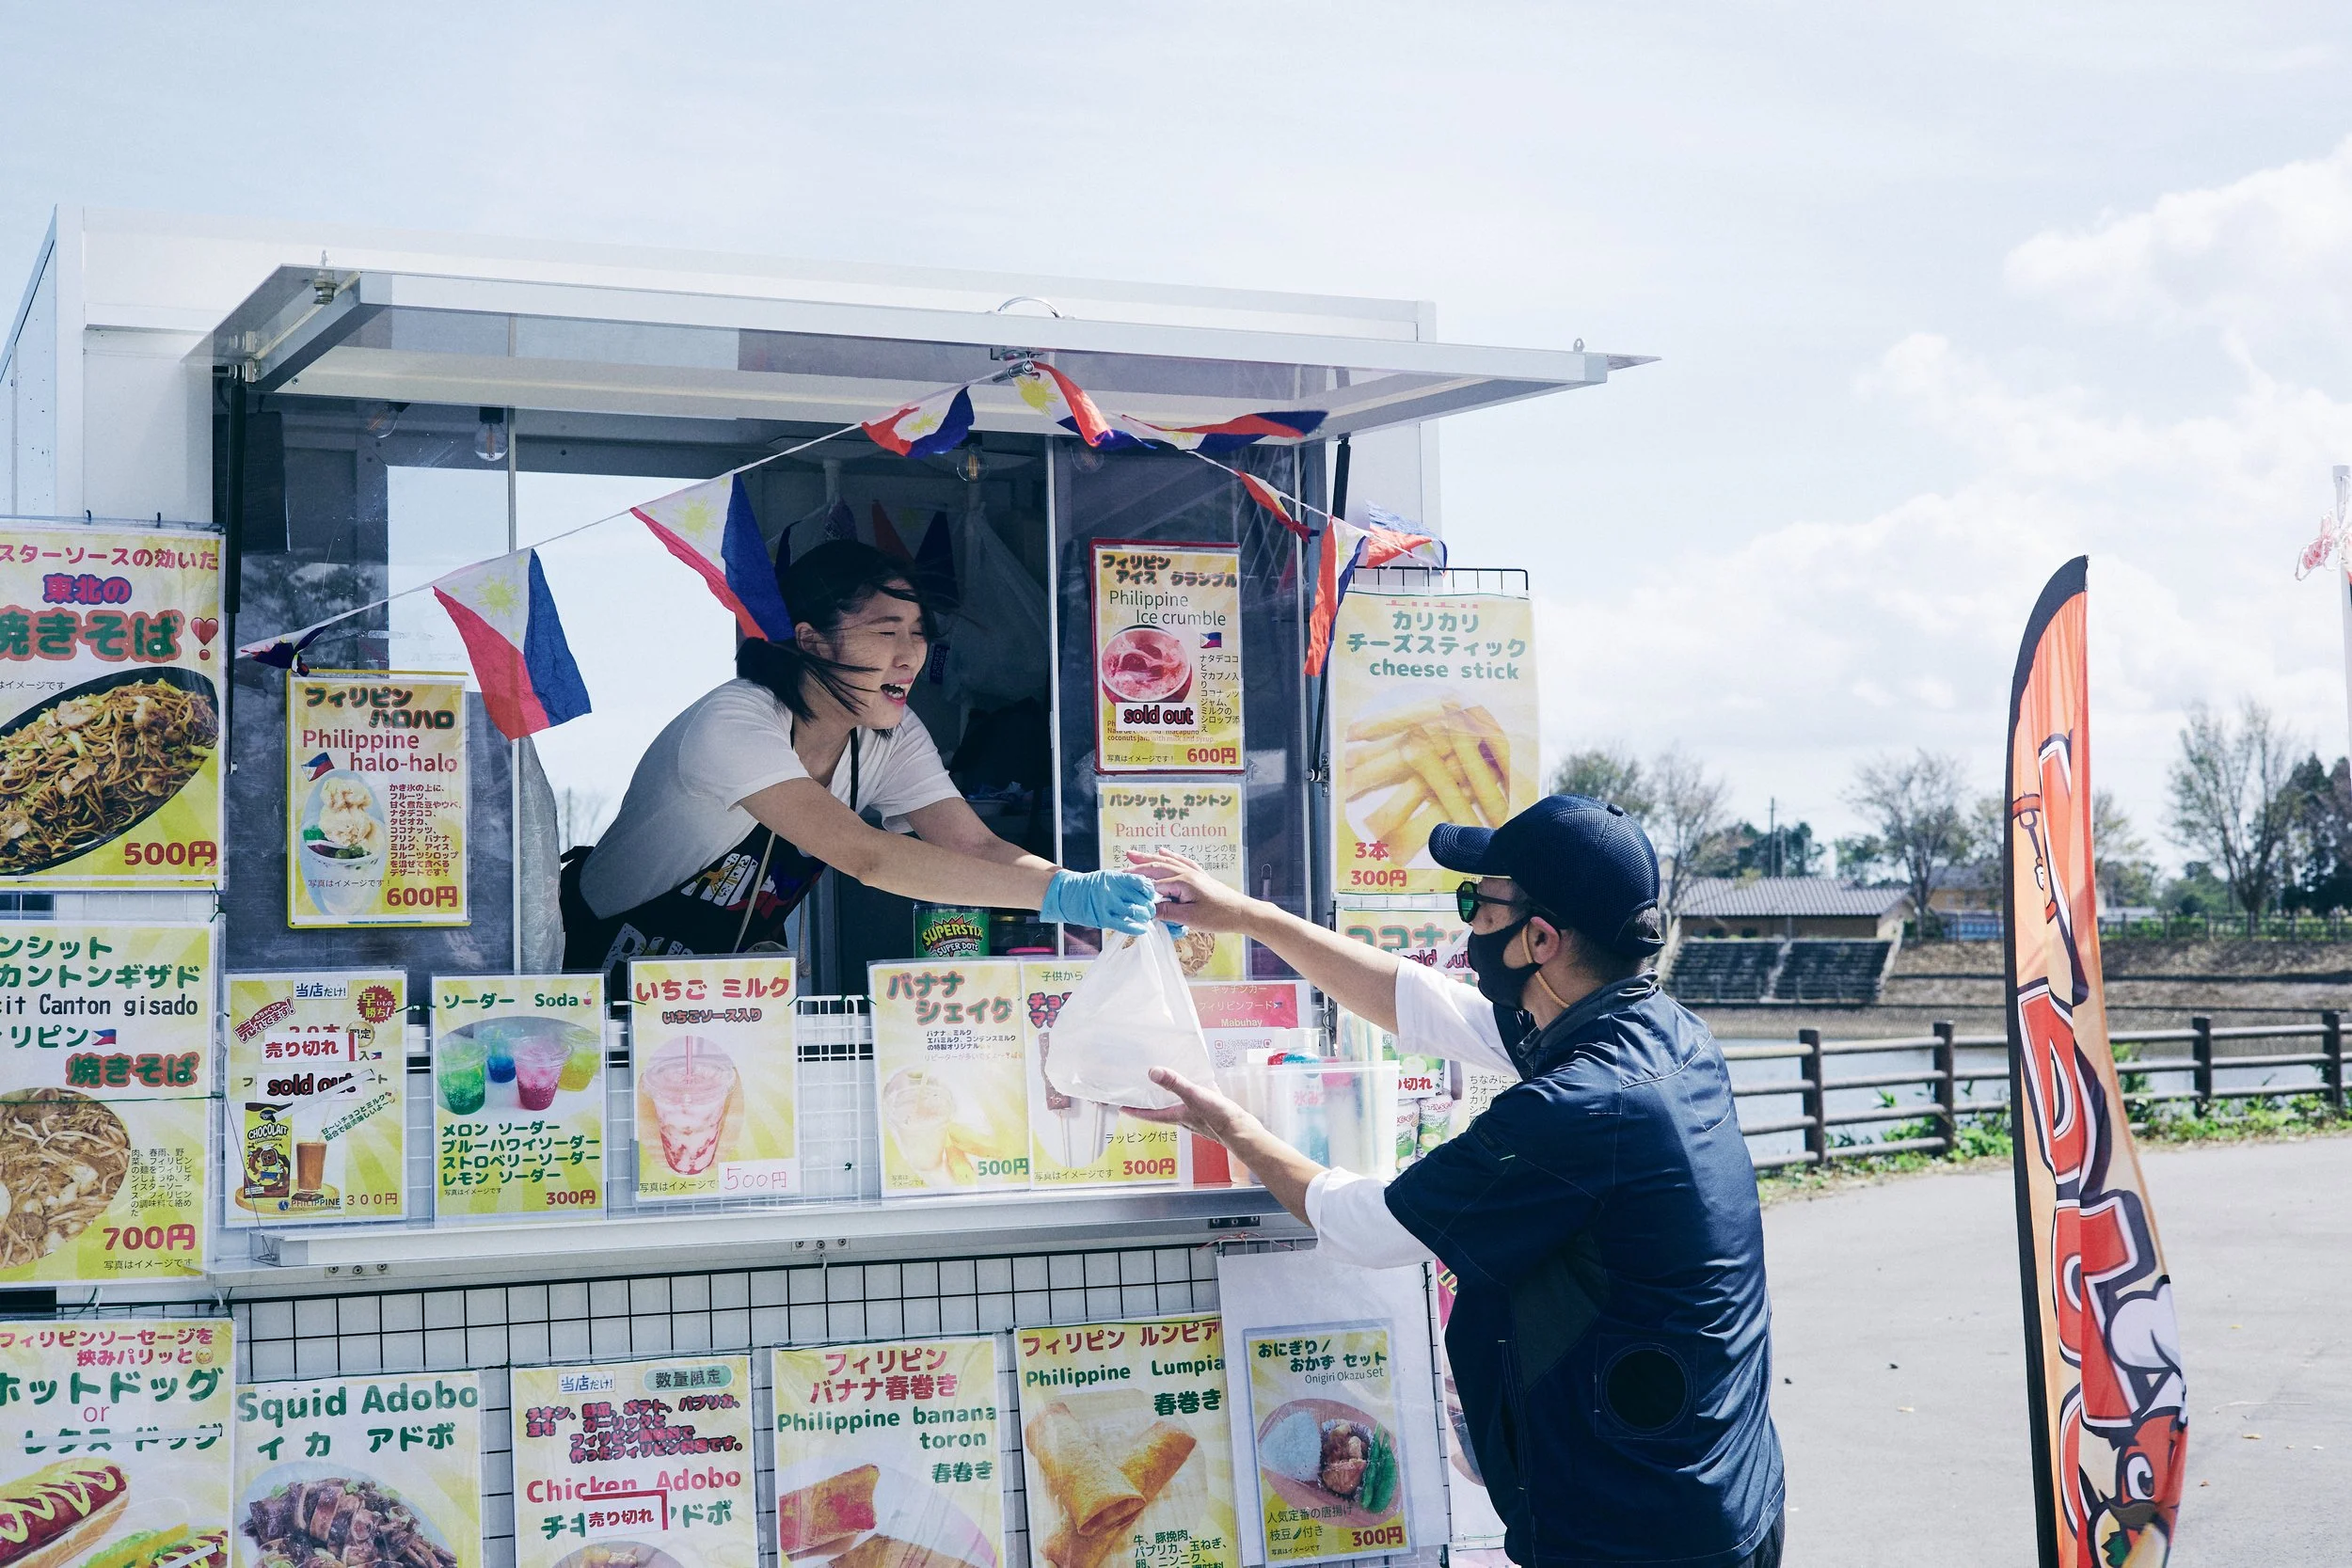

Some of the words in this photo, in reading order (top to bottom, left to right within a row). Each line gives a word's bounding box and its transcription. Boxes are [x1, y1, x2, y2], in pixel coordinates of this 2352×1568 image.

[1102, 554, 1171, 570] フィリピン
[1116, 569, 1157, 584] アイス
[42, 573, 132, 605] 東北の
[1109, 590, 1188, 610] Philippine
[1136, 610, 1158, 624] Ice
[1162, 610, 1226, 626] crumble
[1392, 610, 1479, 633] カリカリ
[1346, 632, 1526, 657] チーズスティック
[1200, 655, 1239, 663] ナタデココ
[1369, 658, 1449, 678] cheese
[1461, 661, 1519, 680] stick
[305, 687, 413, 707] フィリピン
[1200, 689, 1239, 698] ココナッツ
[369, 709, 454, 730] ハロハロ
[1123, 705, 1160, 724] sold
[1163, 707, 1195, 724] out
[303, 729, 420, 752] Philippine
[350, 752, 458, 772] halo-halo
[1187, 747, 1236, 764] 600円
[1109, 794, 1170, 806] パンシット
[1184, 794, 1232, 807] カントン
[1115, 822, 1166, 837] Pancit
[1170, 823, 1228, 837] Canton
[124, 841, 216, 867] 500円
[390, 851, 459, 860] フルーツシロップ
[1355, 840, 1390, 861] 3本
[390, 860, 450, 868] を混ぜて食べる
[1351, 869, 1407, 887] 300円
[387, 886, 457, 908] 600円
[922, 923, 984, 947] SUPERSTIX
[936, 942, 961, 957] SUPER
[961, 942, 979, 953] DOTS
[636, 979, 707, 1002] いちご
[723, 976, 789, 999] ミルク
[886, 971, 965, 1000] バナナ
[1212, 985, 1267, 993] キッチンカー
[0, 993, 26, 1015] it
[40, 993, 111, 1015] Canton
[124, 993, 199, 1017] gisado
[444, 993, 516, 1009] ソーダー
[534, 993, 579, 1007] Soda
[1199, 1001, 1273, 1011] フィリピンフード
[662, 1007, 762, 1024] いちごソース入り
[915, 996, 1012, 1026] シェイク
[1221, 1018, 1263, 1027] Mabuhay
[0, 1024, 88, 1049] リピン
[265, 1039, 339, 1059] 売り切れ
[65, 1052, 200, 1088] 焼きそば
[267, 1072, 314, 1097] sold
[1398, 1077, 1433, 1091] 切れ
[247, 1122, 289, 1140] CHOCOLAIT
[442, 1123, 488, 1137] メロン
[499, 1120, 561, 1135] ソーダー
[1105, 1130, 1178, 1144] ラッピング付き
[442, 1135, 600, 1154] ブルーハワイソーダー
[442, 1151, 600, 1169] ストロベリーソーダー
[977, 1158, 1030, 1176] 500円
[1122, 1158, 1176, 1176] 300円
[443, 1172, 489, 1186] レモン
[499, 1168, 561, 1183] ソーダー
[724, 1167, 787, 1191] 500円
[1034, 1169, 1114, 1181] 写真はイメージです
[132, 1182, 183, 1191] イスターソー
[444, 1187, 501, 1196] 写真はイメージです
[639, 1180, 719, 1193] 写真はイメージで
[546, 1190, 596, 1205] 300円
[103, 1224, 195, 1250] 700円
[0, 1328, 213, 1348] フィリピンソーセージを
[1023, 1329, 1125, 1357] フィリピン
[1139, 1322, 1221, 1347] ルンピア
[77, 1349, 193, 1367] 挟みパリッと
[825, 1347, 947, 1376] フィリピン
[1290, 1354, 1335, 1372] おかず
[1343, 1352, 1387, 1368] セット
[656, 1369, 722, 1388] 数量限定
[1025, 1365, 1131, 1387] Philippine
[1152, 1354, 1226, 1377] Lumpia
[1305, 1372, 1335, 1385] Onigiri
[1337, 1370, 1364, 1381] Okazu
[1367, 1367, 1384, 1378] set
[0, 1368, 224, 1406] ホットドッグ
[810, 1373, 958, 1404] バナナ春巻き
[237, 1386, 347, 1428] Squid
[361, 1380, 478, 1415] Adobo
[1153, 1388, 1221, 1416] 春巻き
[83, 1405, 110, 1422] or
[778, 1409, 900, 1434] Philippine
[913, 1406, 996, 1425] banana
[367, 1422, 455, 1453] アドボ
[919, 1432, 987, 1449] toron
[931, 1460, 993, 1483] 春巻き
[527, 1476, 637, 1503] Chicken
[656, 1465, 741, 1492] Adobo
[588, 1508, 654, 1528] 売り切れ
[1267, 1505, 1353, 1524] 人気定番の唐揚げ
[1270, 1528, 1292, 1542] 枝豆
[1302, 1526, 1324, 1538] 付き
[1351, 1526, 1404, 1547] 300円
[1271, 1544, 1321, 1556] 写真はイメージです
